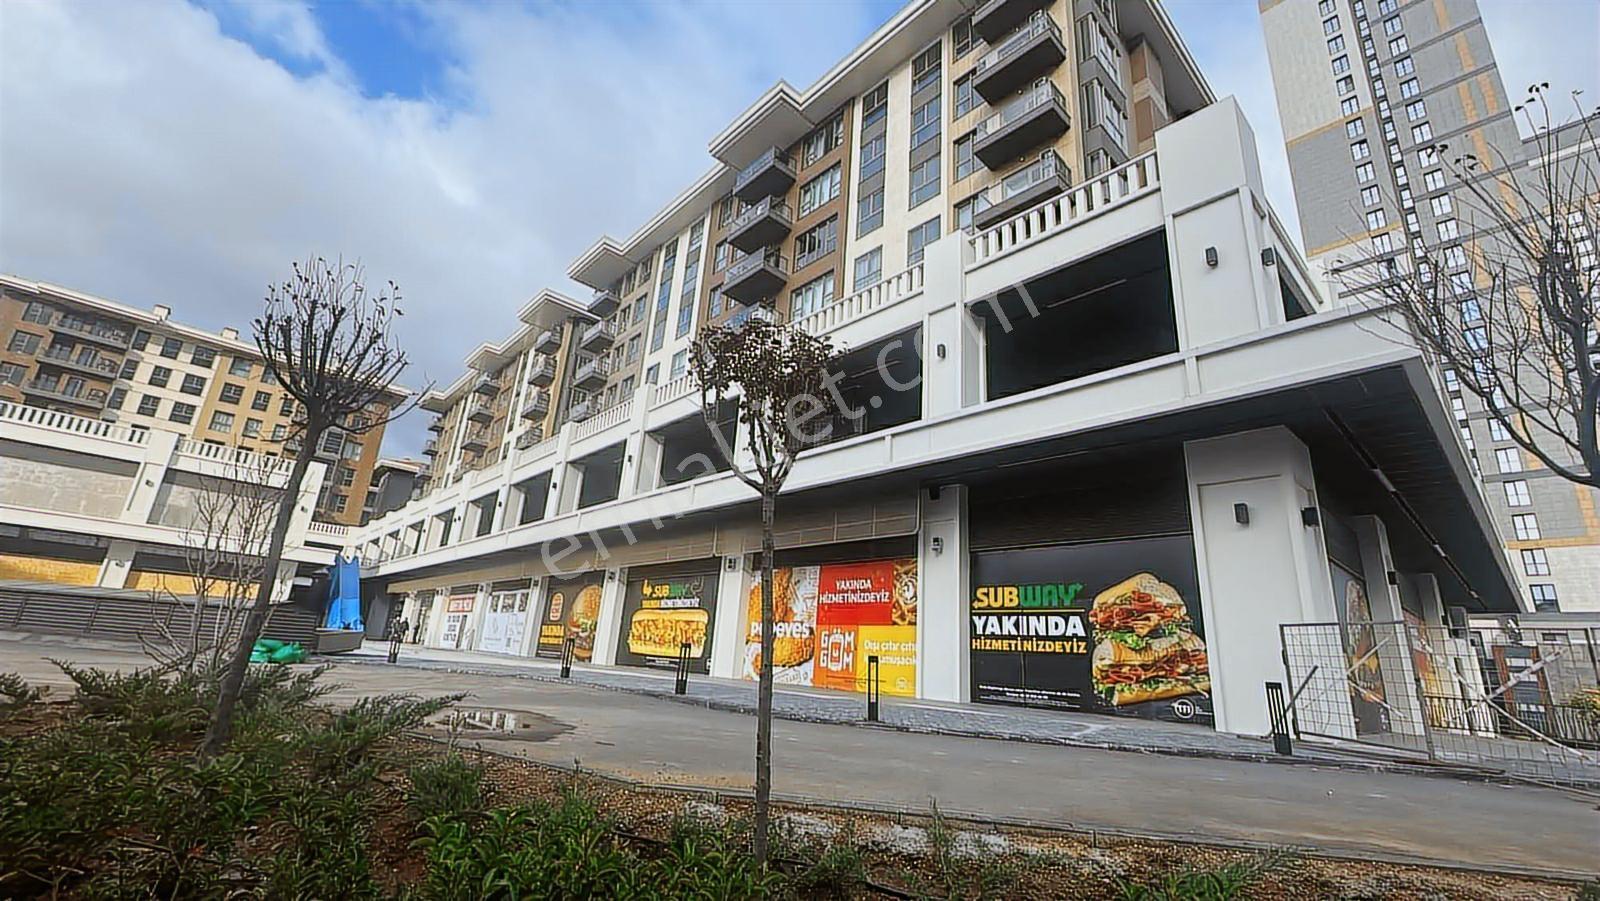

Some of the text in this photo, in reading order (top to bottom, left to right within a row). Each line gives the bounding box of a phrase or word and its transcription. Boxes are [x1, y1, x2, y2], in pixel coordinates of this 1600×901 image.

[835, 578, 872, 590] YAKINDA
[973, 583, 1084, 608] SUBWAY
[972, 615, 1086, 637] YAKINDA
[972, 637, 1087, 654] HİZMETİNİZDEYİZ
